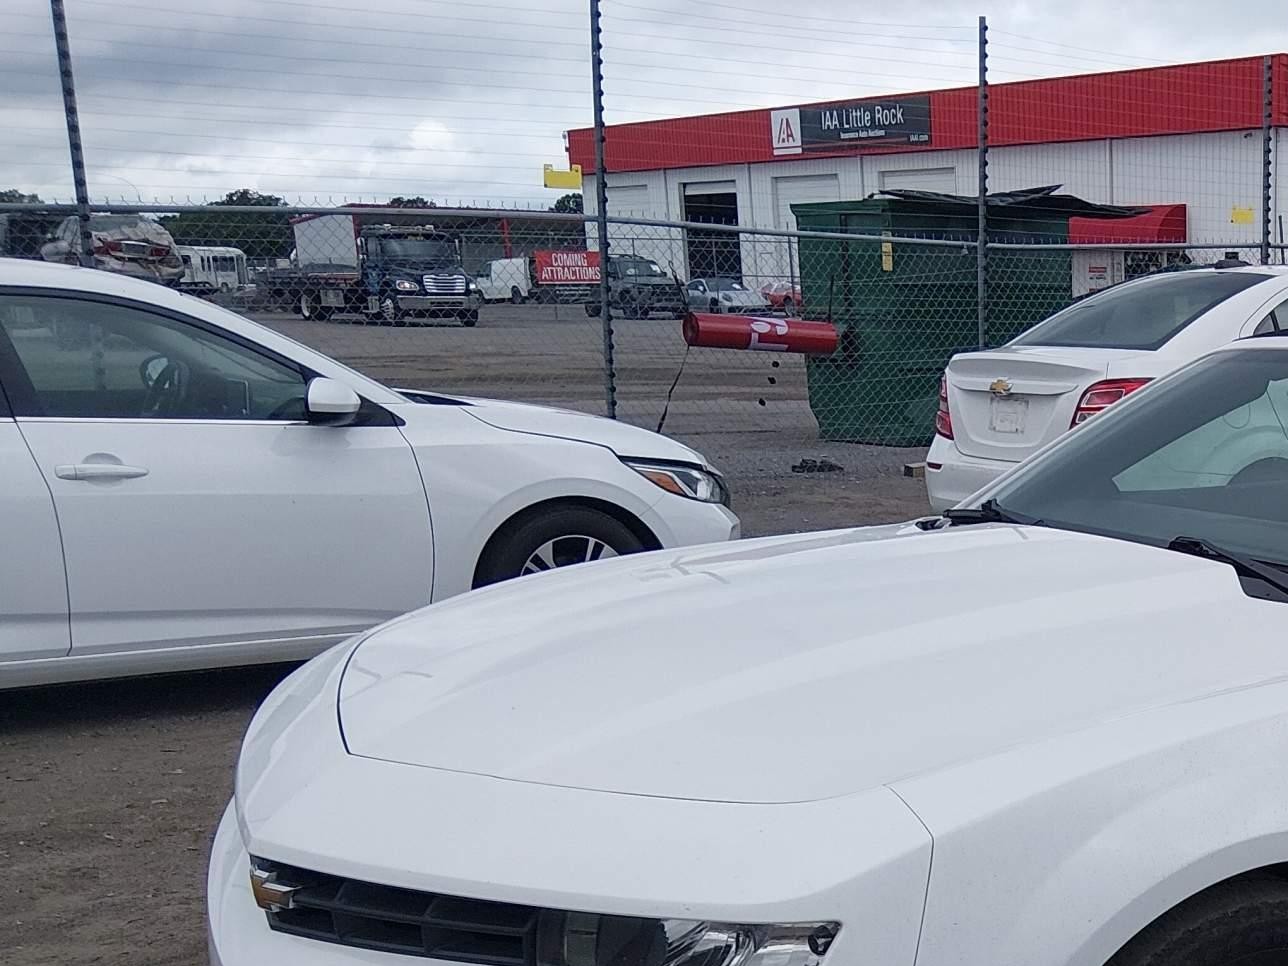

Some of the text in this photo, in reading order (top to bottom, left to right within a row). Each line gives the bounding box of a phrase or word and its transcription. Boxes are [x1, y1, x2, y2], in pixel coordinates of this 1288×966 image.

[821, 104, 905, 130] IAA Little Rock
[551, 253, 588, 266] COMING
[542, 267, 601, 280] ATTRACTIONS
